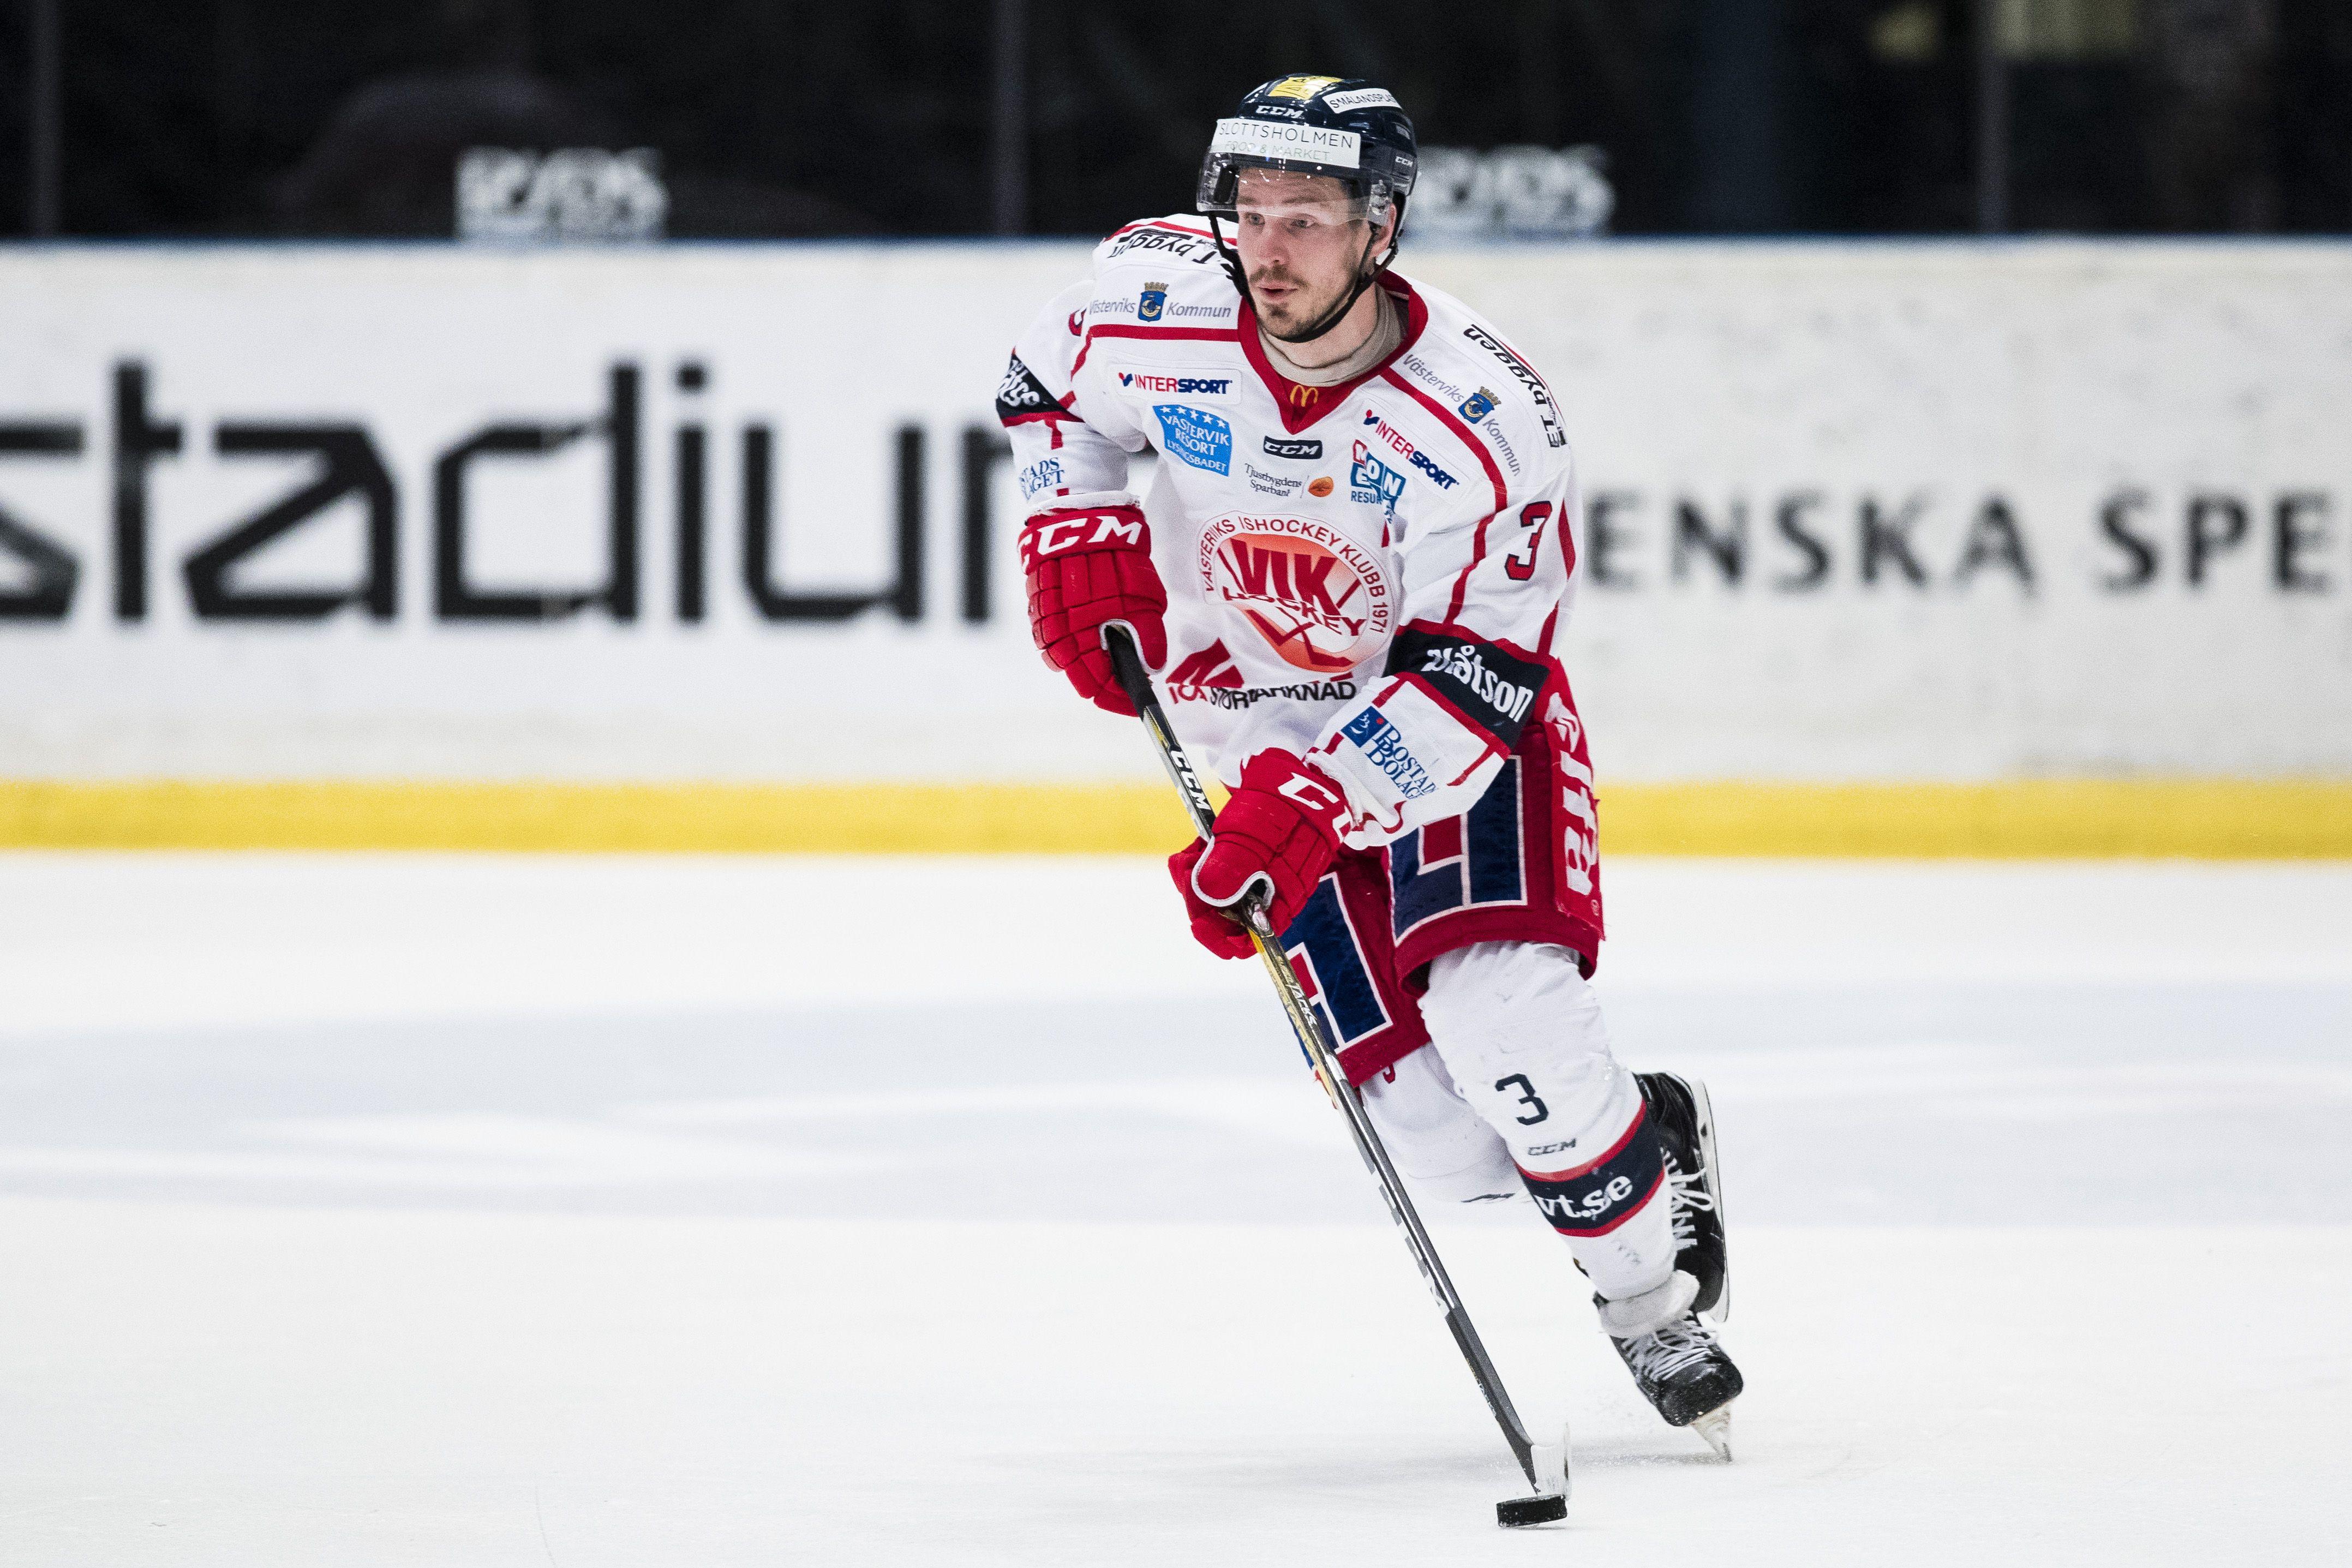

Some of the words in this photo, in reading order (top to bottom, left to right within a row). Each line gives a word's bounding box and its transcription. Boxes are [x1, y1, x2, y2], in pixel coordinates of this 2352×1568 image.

[1218, 122, 1353, 149] SLOTTSHOLMEN
[1255, 105, 1304, 119] CCM
[1395, 155, 1414, 167] CCM
[1166, 302, 1231, 318] Kommun
[1134, 374, 1229, 394] INTERSPORT
[1463, 327, 1547, 405] byggen
[1402, 354, 1465, 403] Västerviks
[1482, 418, 1521, 477] Kommun
[1264, 441, 1320, 455] CCM
[1375, 420, 1457, 490] INTERSPORT
[1018, 516, 1143, 577] CCM
[1504, 500, 1553, 581] 3
[1229, 537, 1342, 617] VIK
[1237, 516, 1342, 547] ISHOCKEY
[1339, 544, 1386, 597] KLUBB
[1369, 602, 1389, 633] 1971
[1170, 750, 1212, 811] CCM
[1494, 1073, 1549, 1126] 3
[1527, 1138, 1577, 1156] CCM
[1533, 1175, 1633, 1218] vt.se
